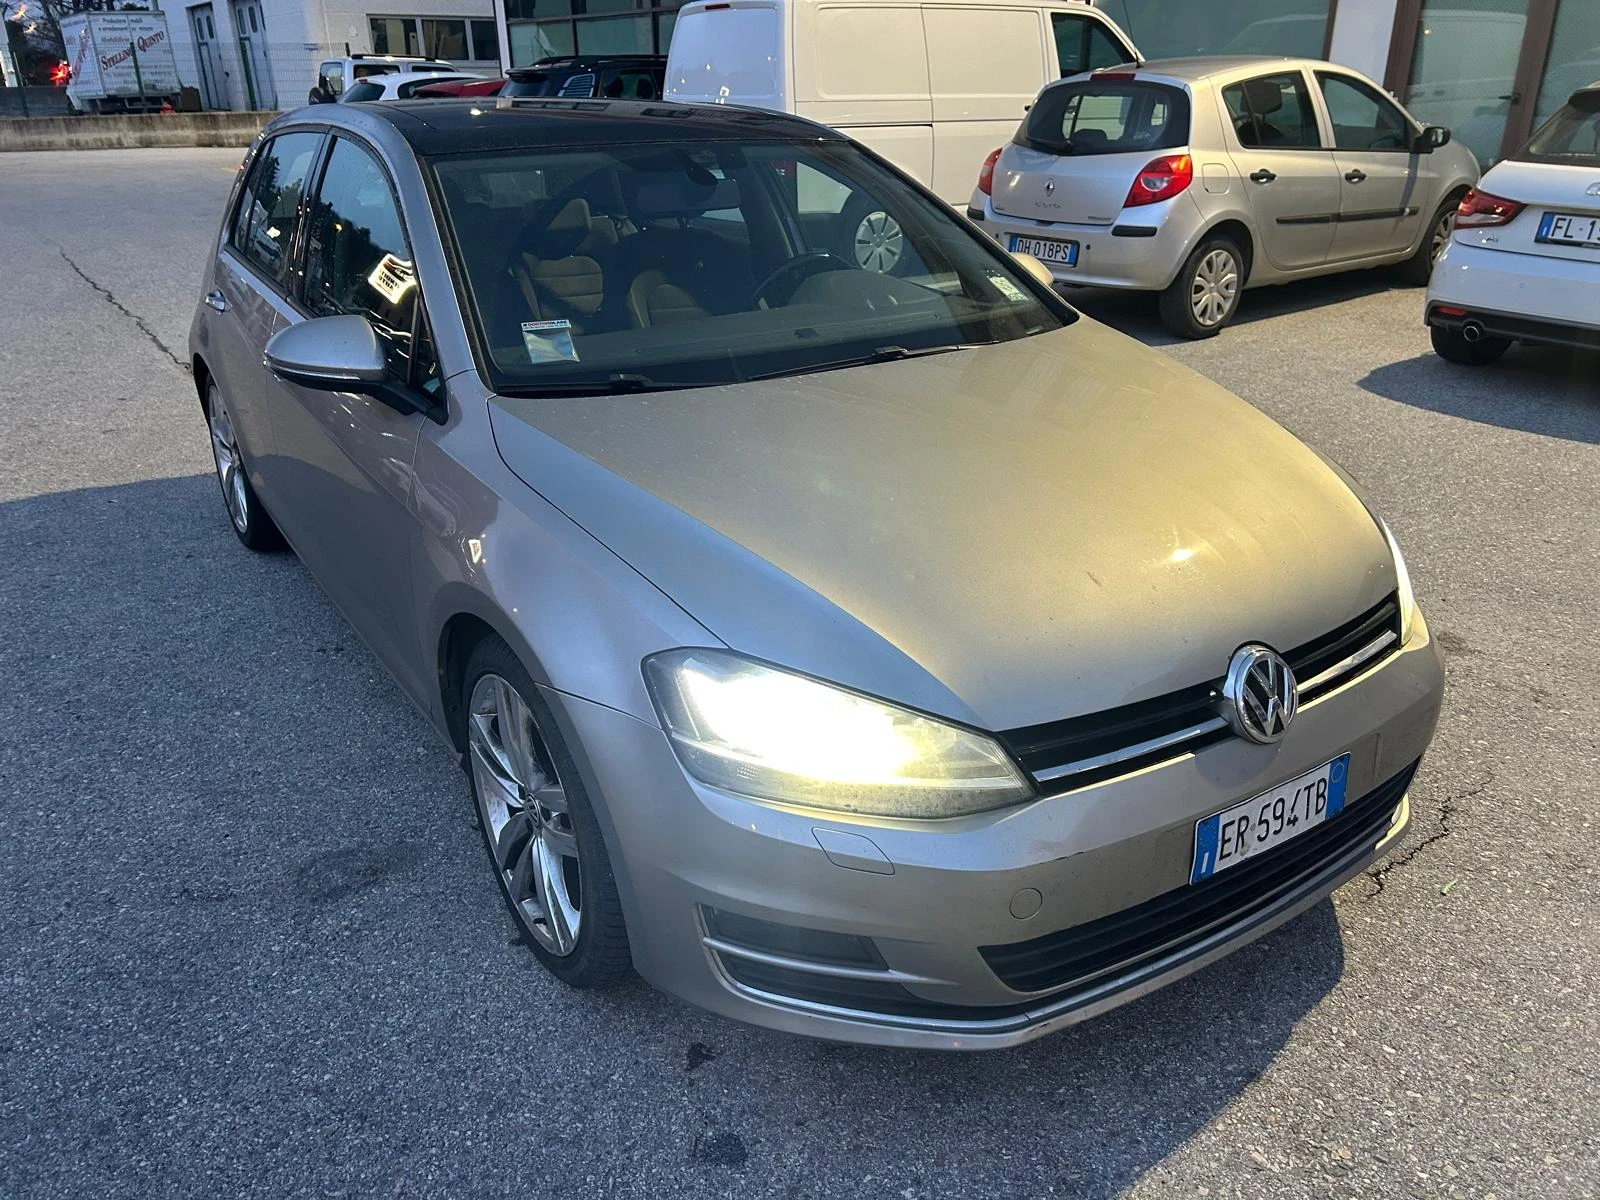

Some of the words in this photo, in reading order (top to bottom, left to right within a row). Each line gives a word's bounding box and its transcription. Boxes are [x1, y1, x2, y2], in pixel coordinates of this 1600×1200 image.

[1035, 201, 1062, 209] CLIO
[1551, 217, 1573, 239] FL
[1587, 220, 1600, 242] 1
[1016, 239, 1032, 255] DH
[1033, 242, 1069, 261] 018PS
[1219, 814, 1250, 861] ER
[1256, 777, 1327, 842] 594TB
